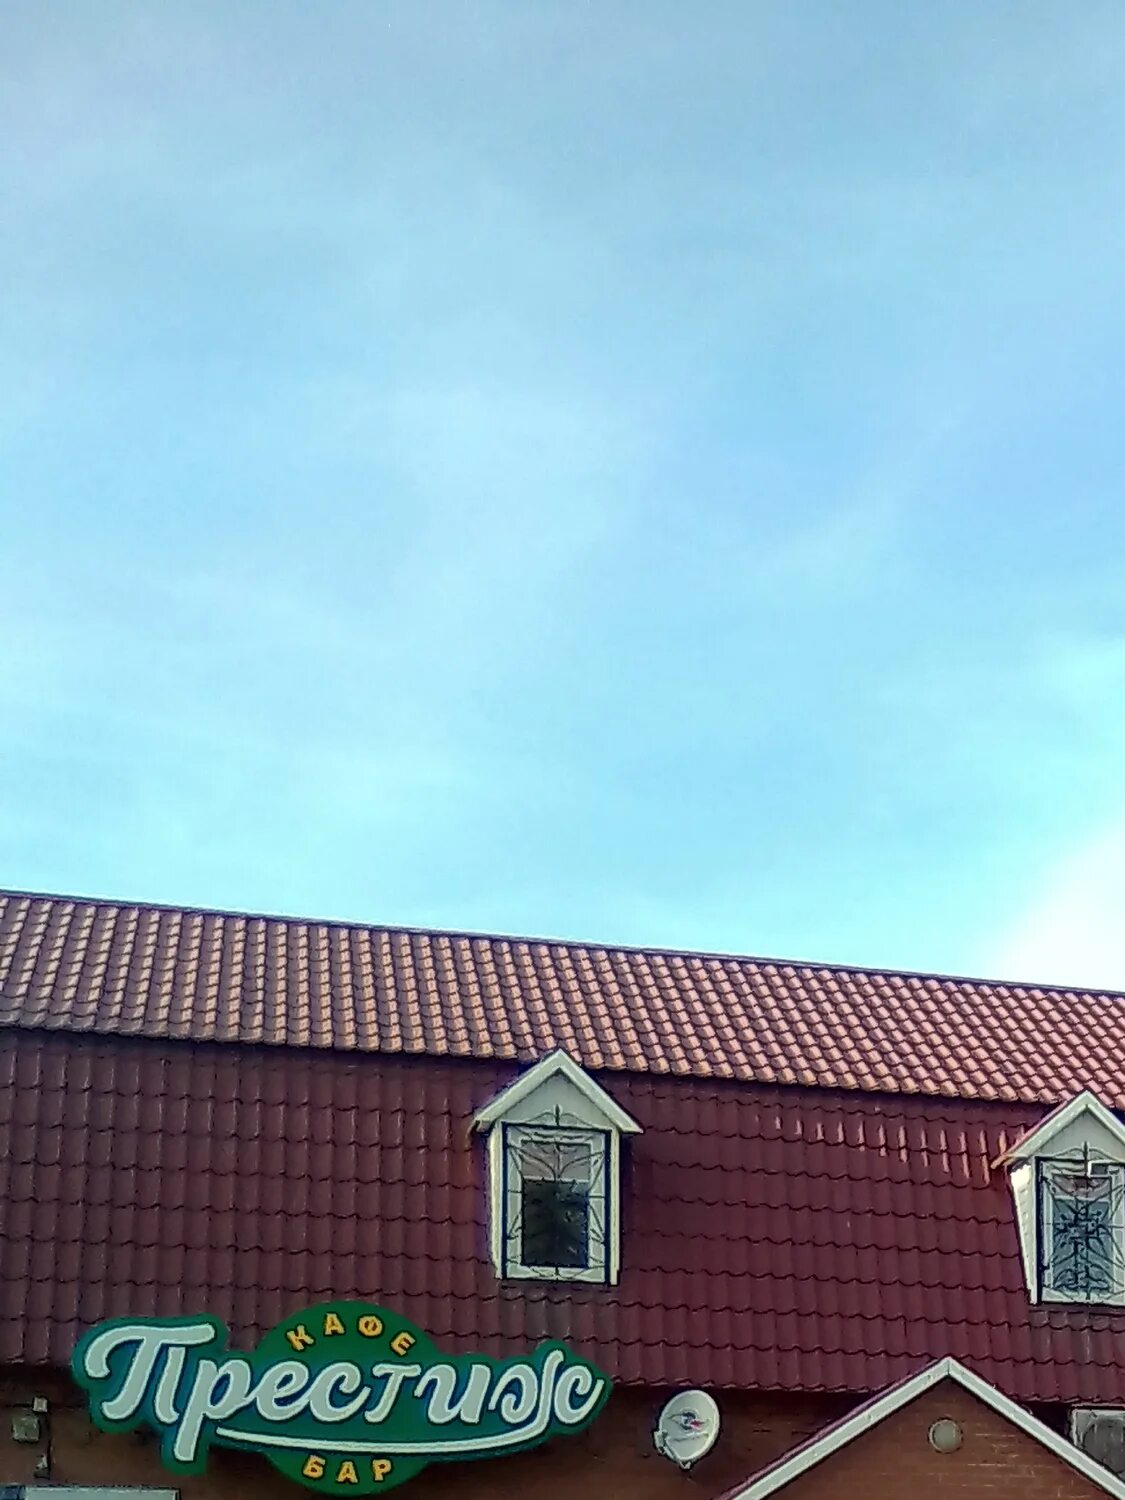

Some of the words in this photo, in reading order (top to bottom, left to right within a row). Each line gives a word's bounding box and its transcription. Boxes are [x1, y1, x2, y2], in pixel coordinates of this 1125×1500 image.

[286, 1312, 417, 1356] КАФЕ
[85, 1322, 604, 1461] Престиж
[303, 1455, 391, 1484] БАР
